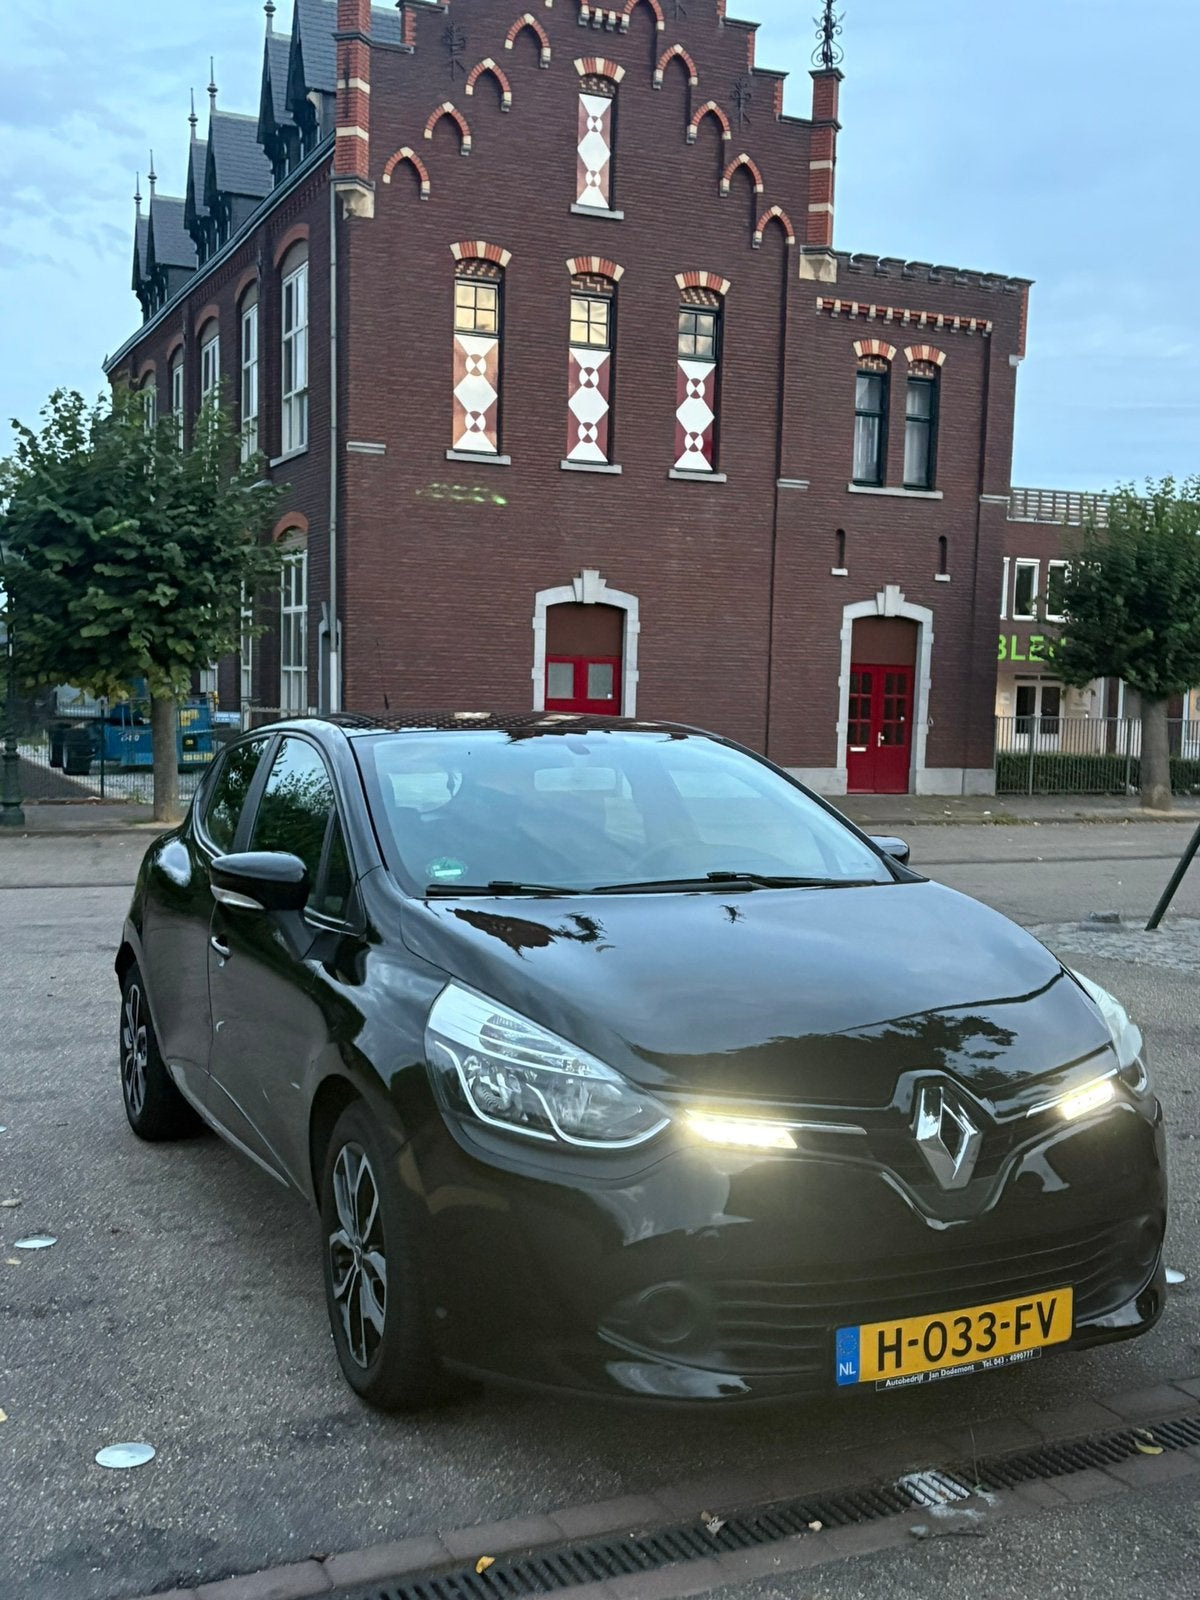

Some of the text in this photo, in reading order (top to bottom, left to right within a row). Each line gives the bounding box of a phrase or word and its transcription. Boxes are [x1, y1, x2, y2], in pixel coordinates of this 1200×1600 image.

[877, 1297, 1057, 1372] H-033-FV
[839, 1361, 856, 1376] NL
[885, 1372, 924, 1388] Autobedrijf
[928, 1370, 940, 1381] Jan
